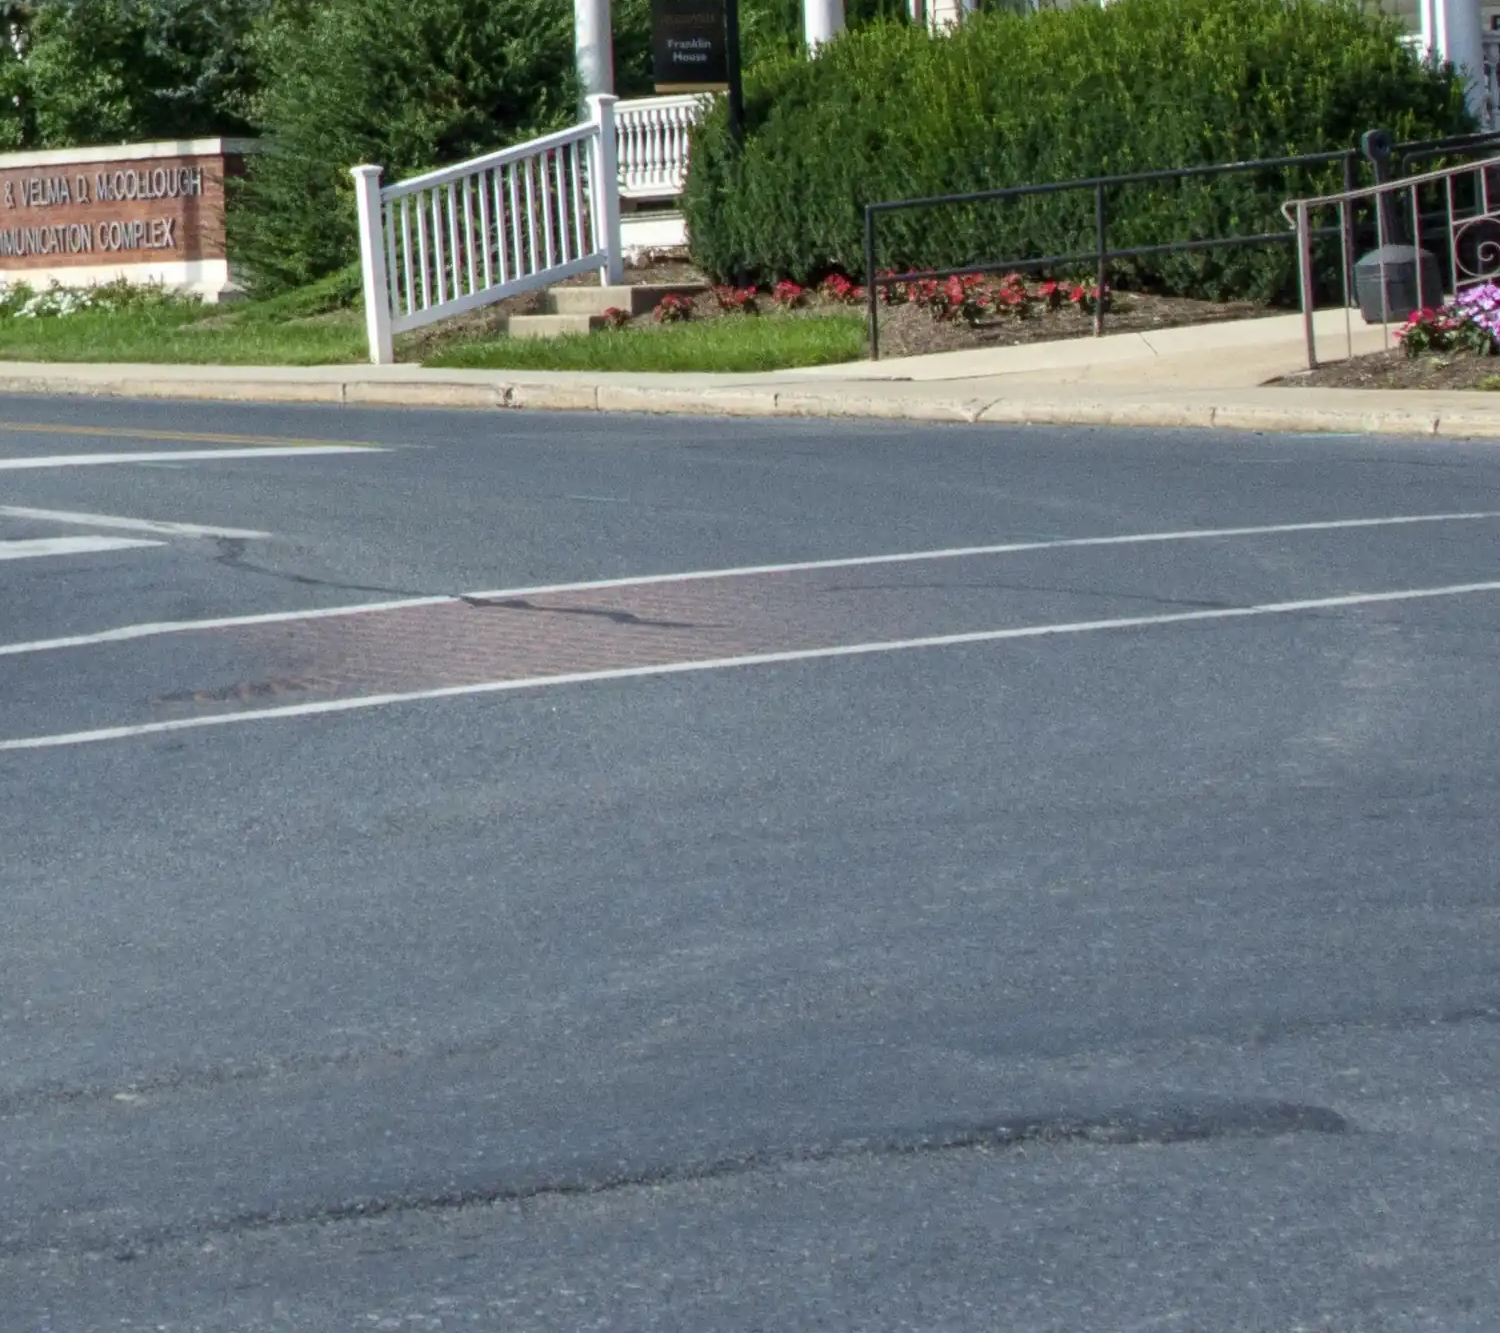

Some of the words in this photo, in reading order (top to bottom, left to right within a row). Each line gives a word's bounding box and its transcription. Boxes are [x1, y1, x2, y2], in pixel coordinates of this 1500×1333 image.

[666, 38, 712, 50] Franklin
[672, 51, 708, 62] House
[4, 180, 16, 210] &
[21, 174, 72, 206] VELMA
[95, 165, 204, 202] McCOLLOUGH
[99, 216, 177, 251] COMPLEX
